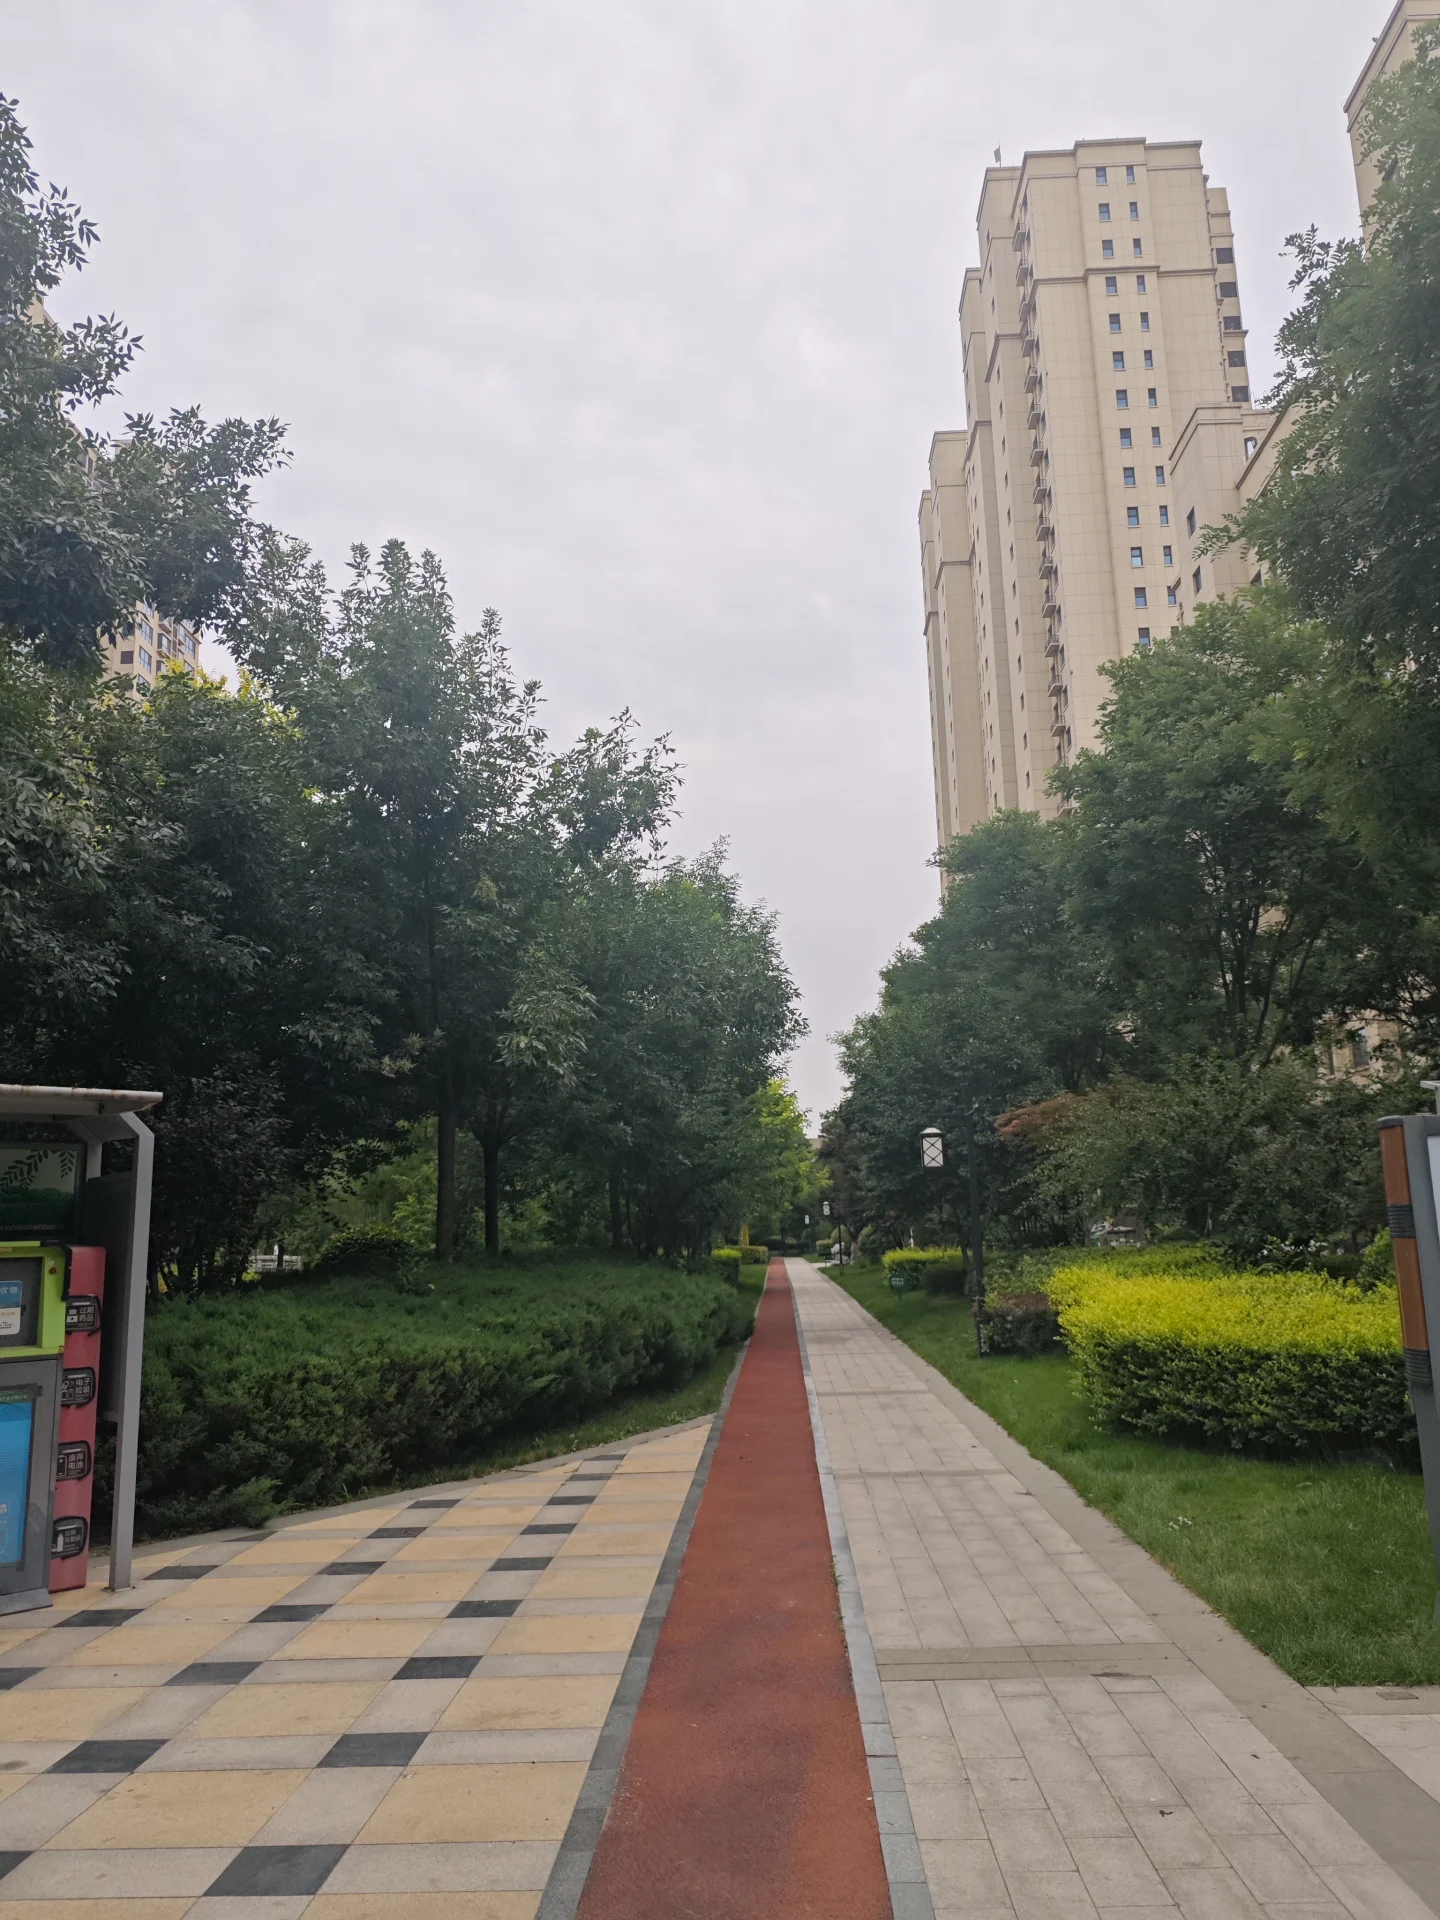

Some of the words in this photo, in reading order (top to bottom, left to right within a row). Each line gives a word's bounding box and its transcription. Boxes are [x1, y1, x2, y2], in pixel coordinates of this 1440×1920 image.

[79, 1306, 95, 1314] 过期
[79, 1314, 94, 1322] 药品
[75, 1377, 90, 1385] 电子
[75, 1385, 90, 1393] 垃圾
[68, 1453, 84, 1461] 废弃
[68, 1461, 84, 1469] 电池
